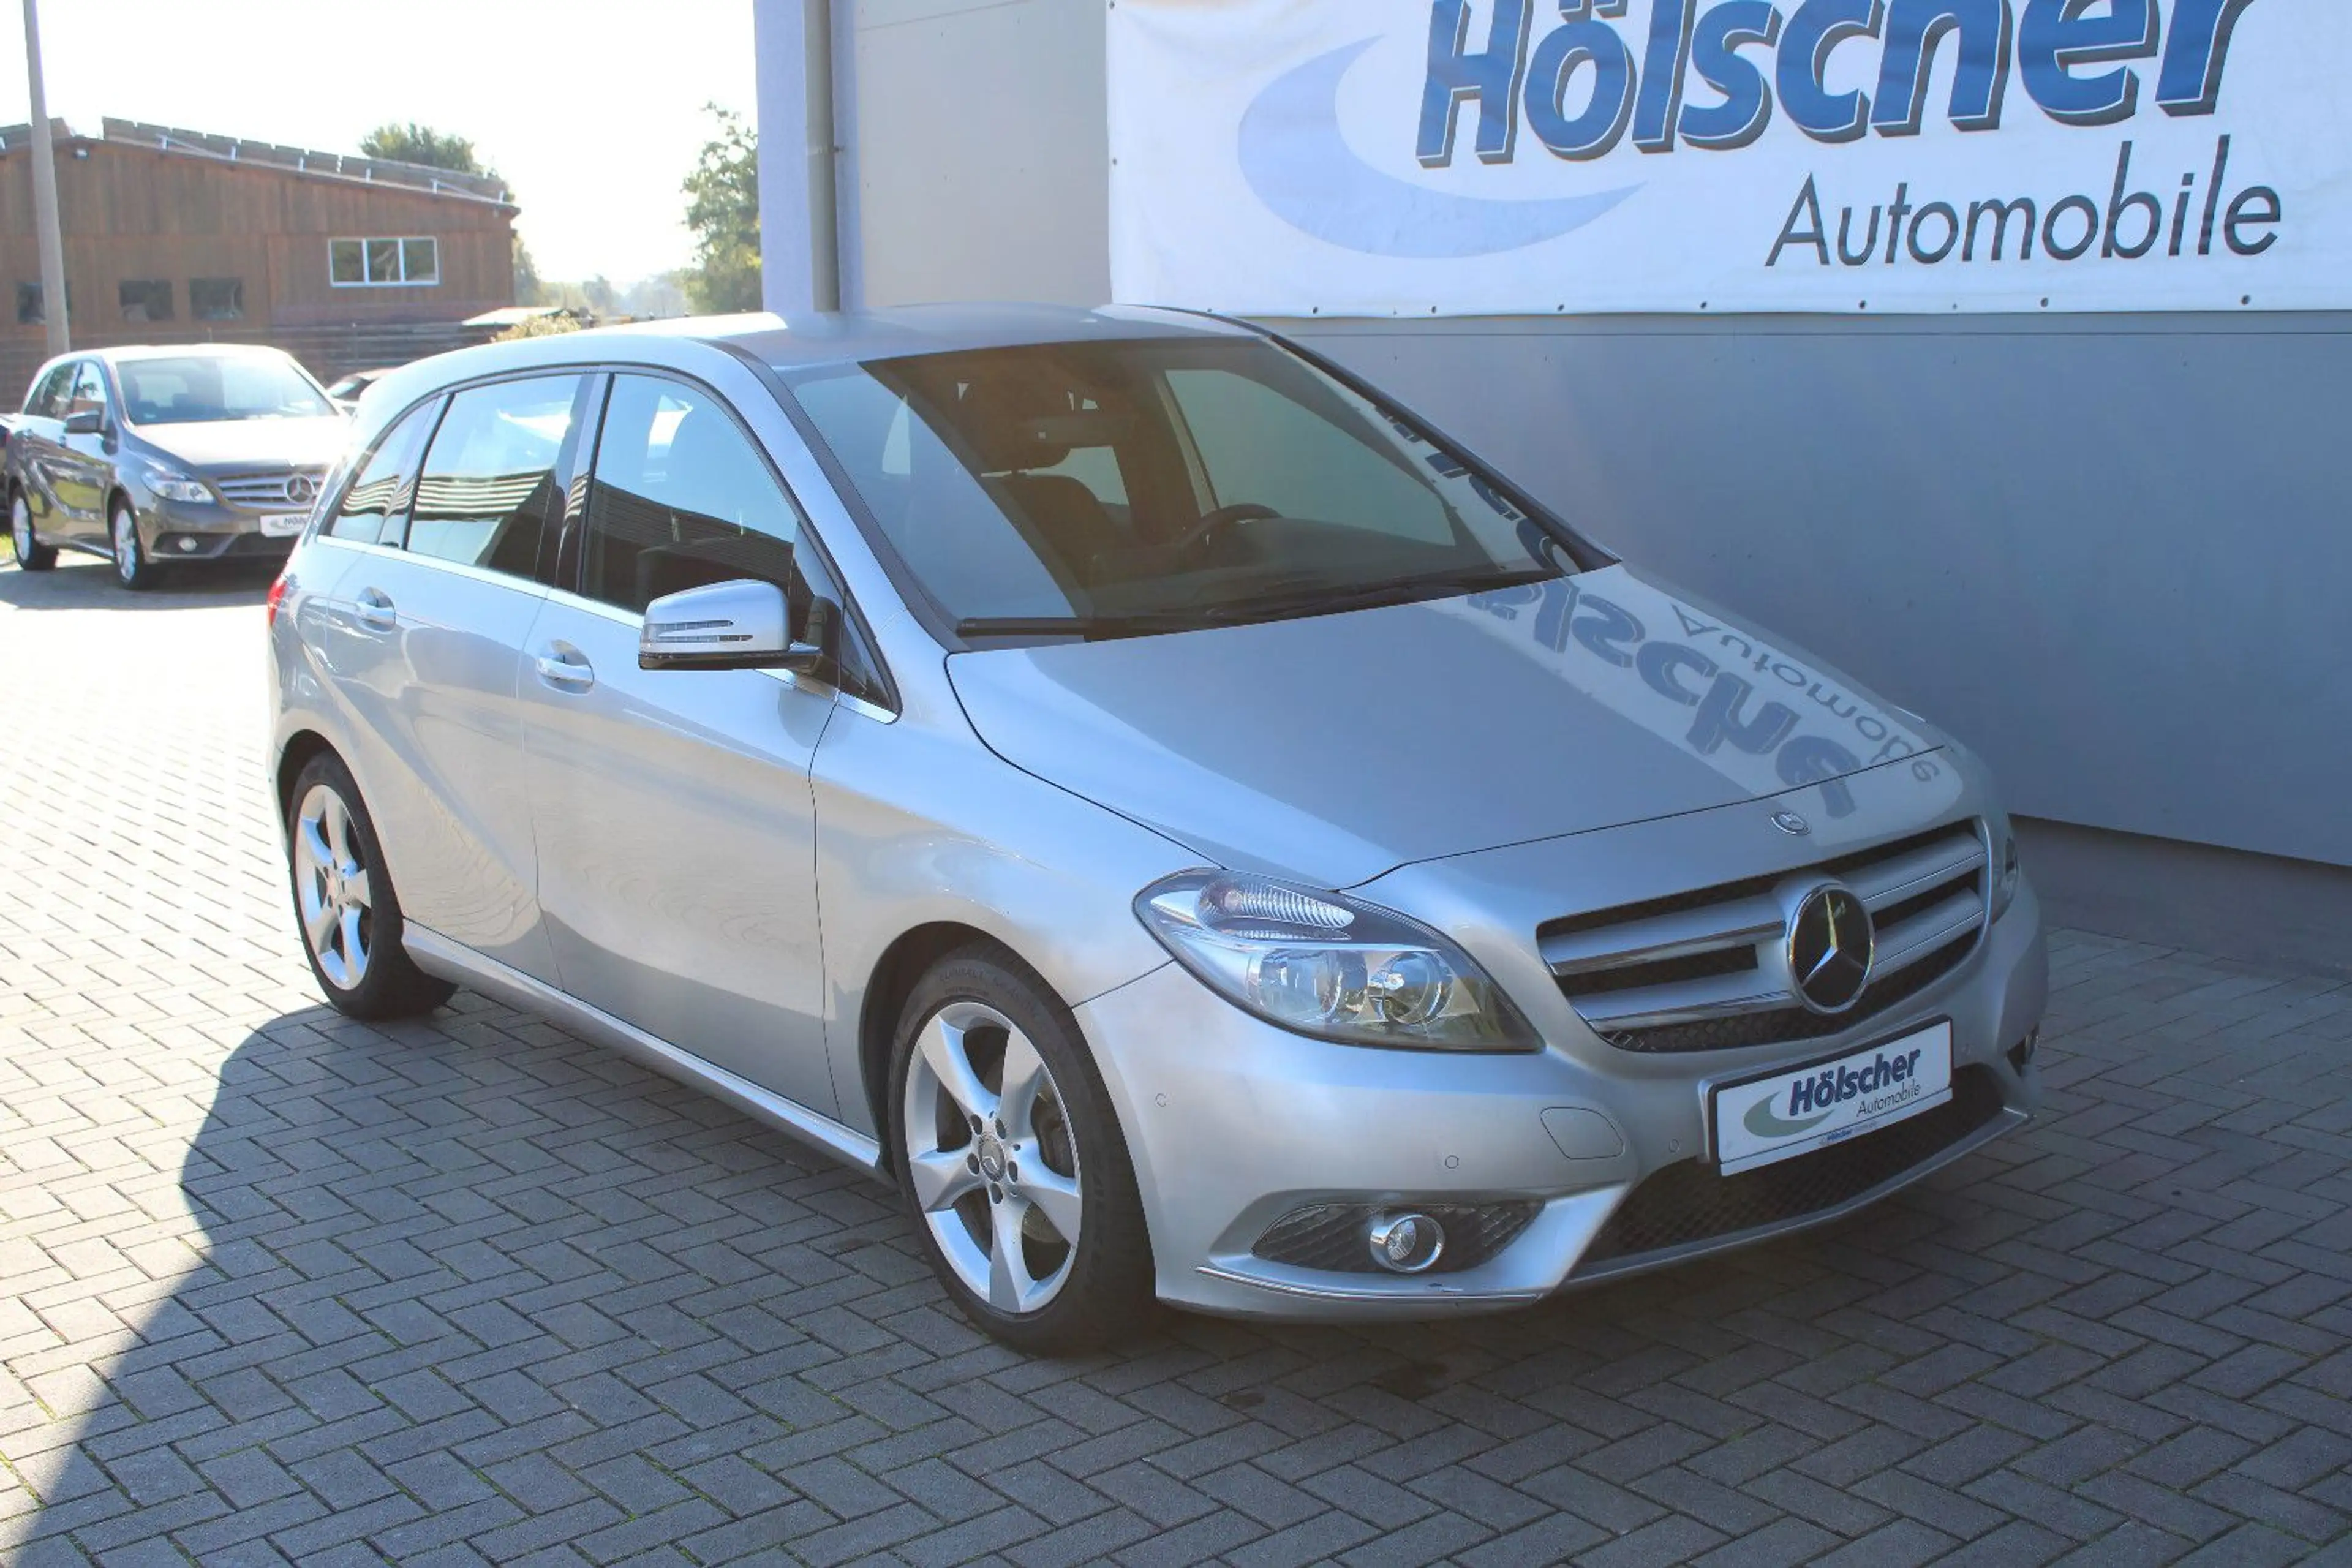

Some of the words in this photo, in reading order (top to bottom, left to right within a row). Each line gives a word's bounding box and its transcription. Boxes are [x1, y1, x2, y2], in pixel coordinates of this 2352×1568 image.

[1415, 0, 2255, 168] Hölscher
[1765, 134, 2281, 266] Automobile
[1789, 1048, 1921, 1117] Hölscher
[1856, 1079, 1921, 1117] Automobile
